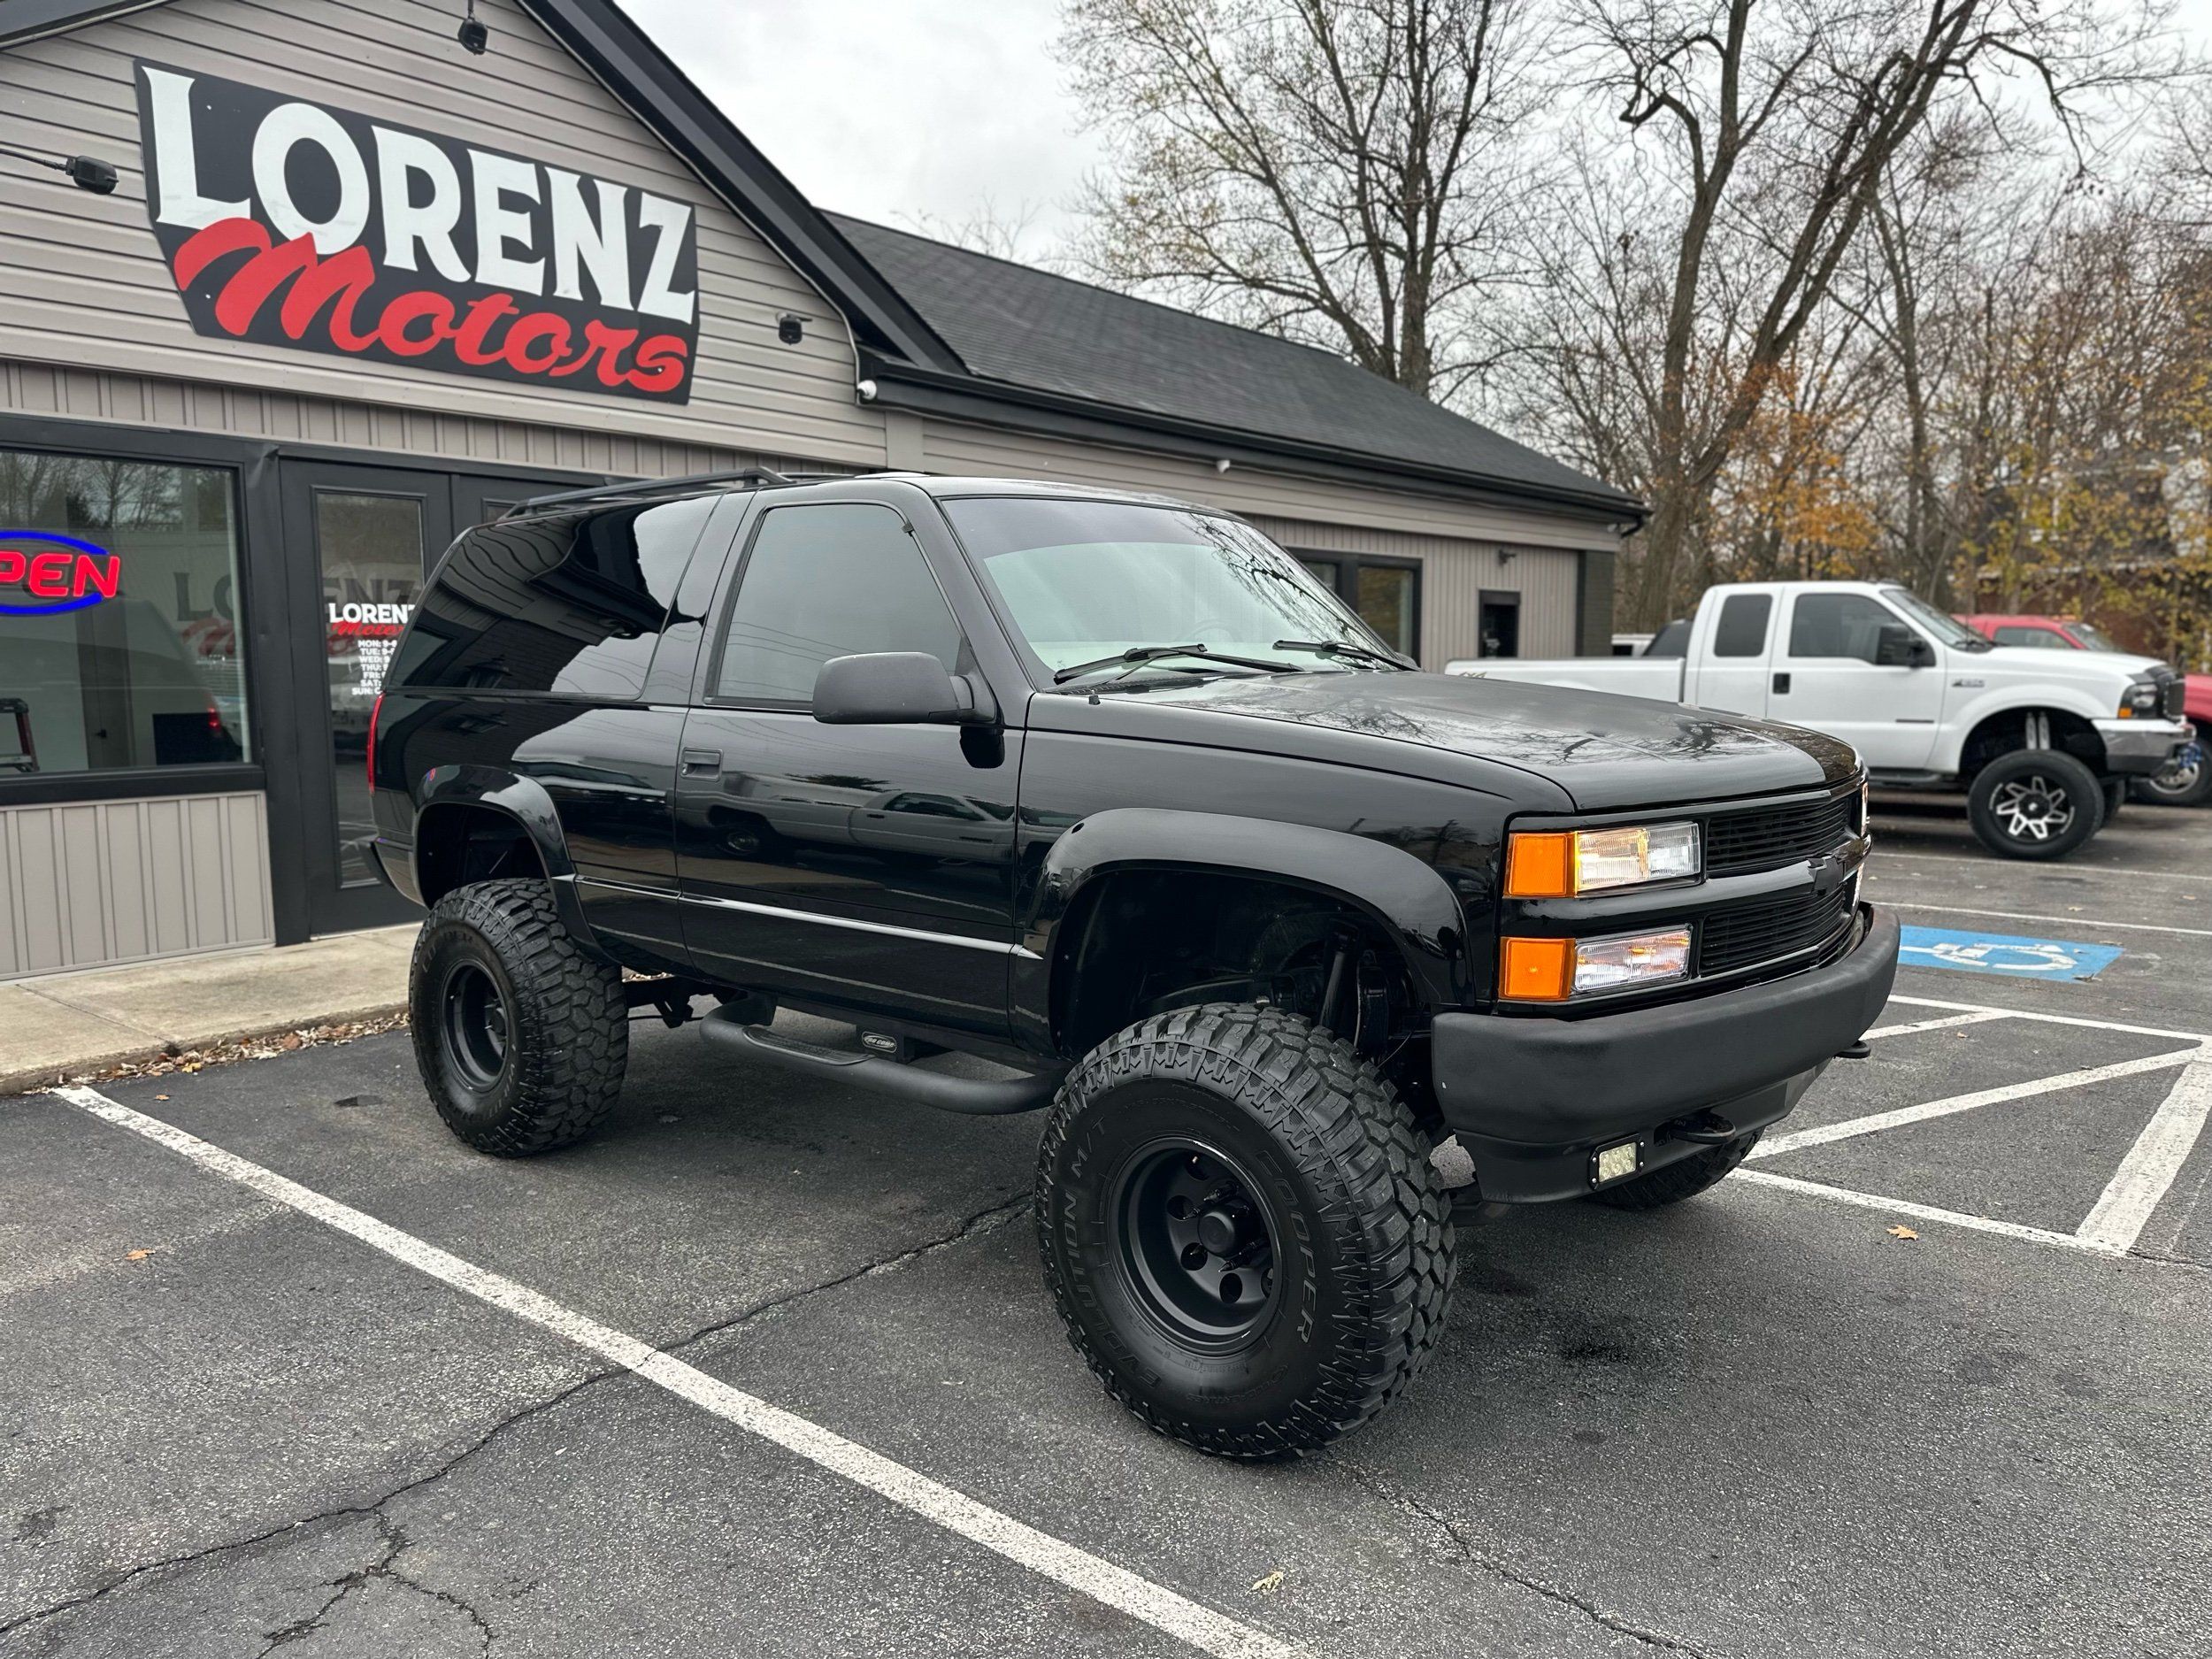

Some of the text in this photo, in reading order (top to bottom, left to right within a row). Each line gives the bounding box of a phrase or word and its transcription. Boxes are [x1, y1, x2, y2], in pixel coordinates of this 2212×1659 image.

[142, 66, 695, 325] LORENZ
[175, 218, 687, 392] Motors
[0, 552, 120, 598] PEN
[331, 620, 405, 636] Motor
[351, 687, 373, 695] SUN:
[1063, 1188, 1162, 1389] EVOLUTION
[1255, 1149, 1317, 1344] COOPER
